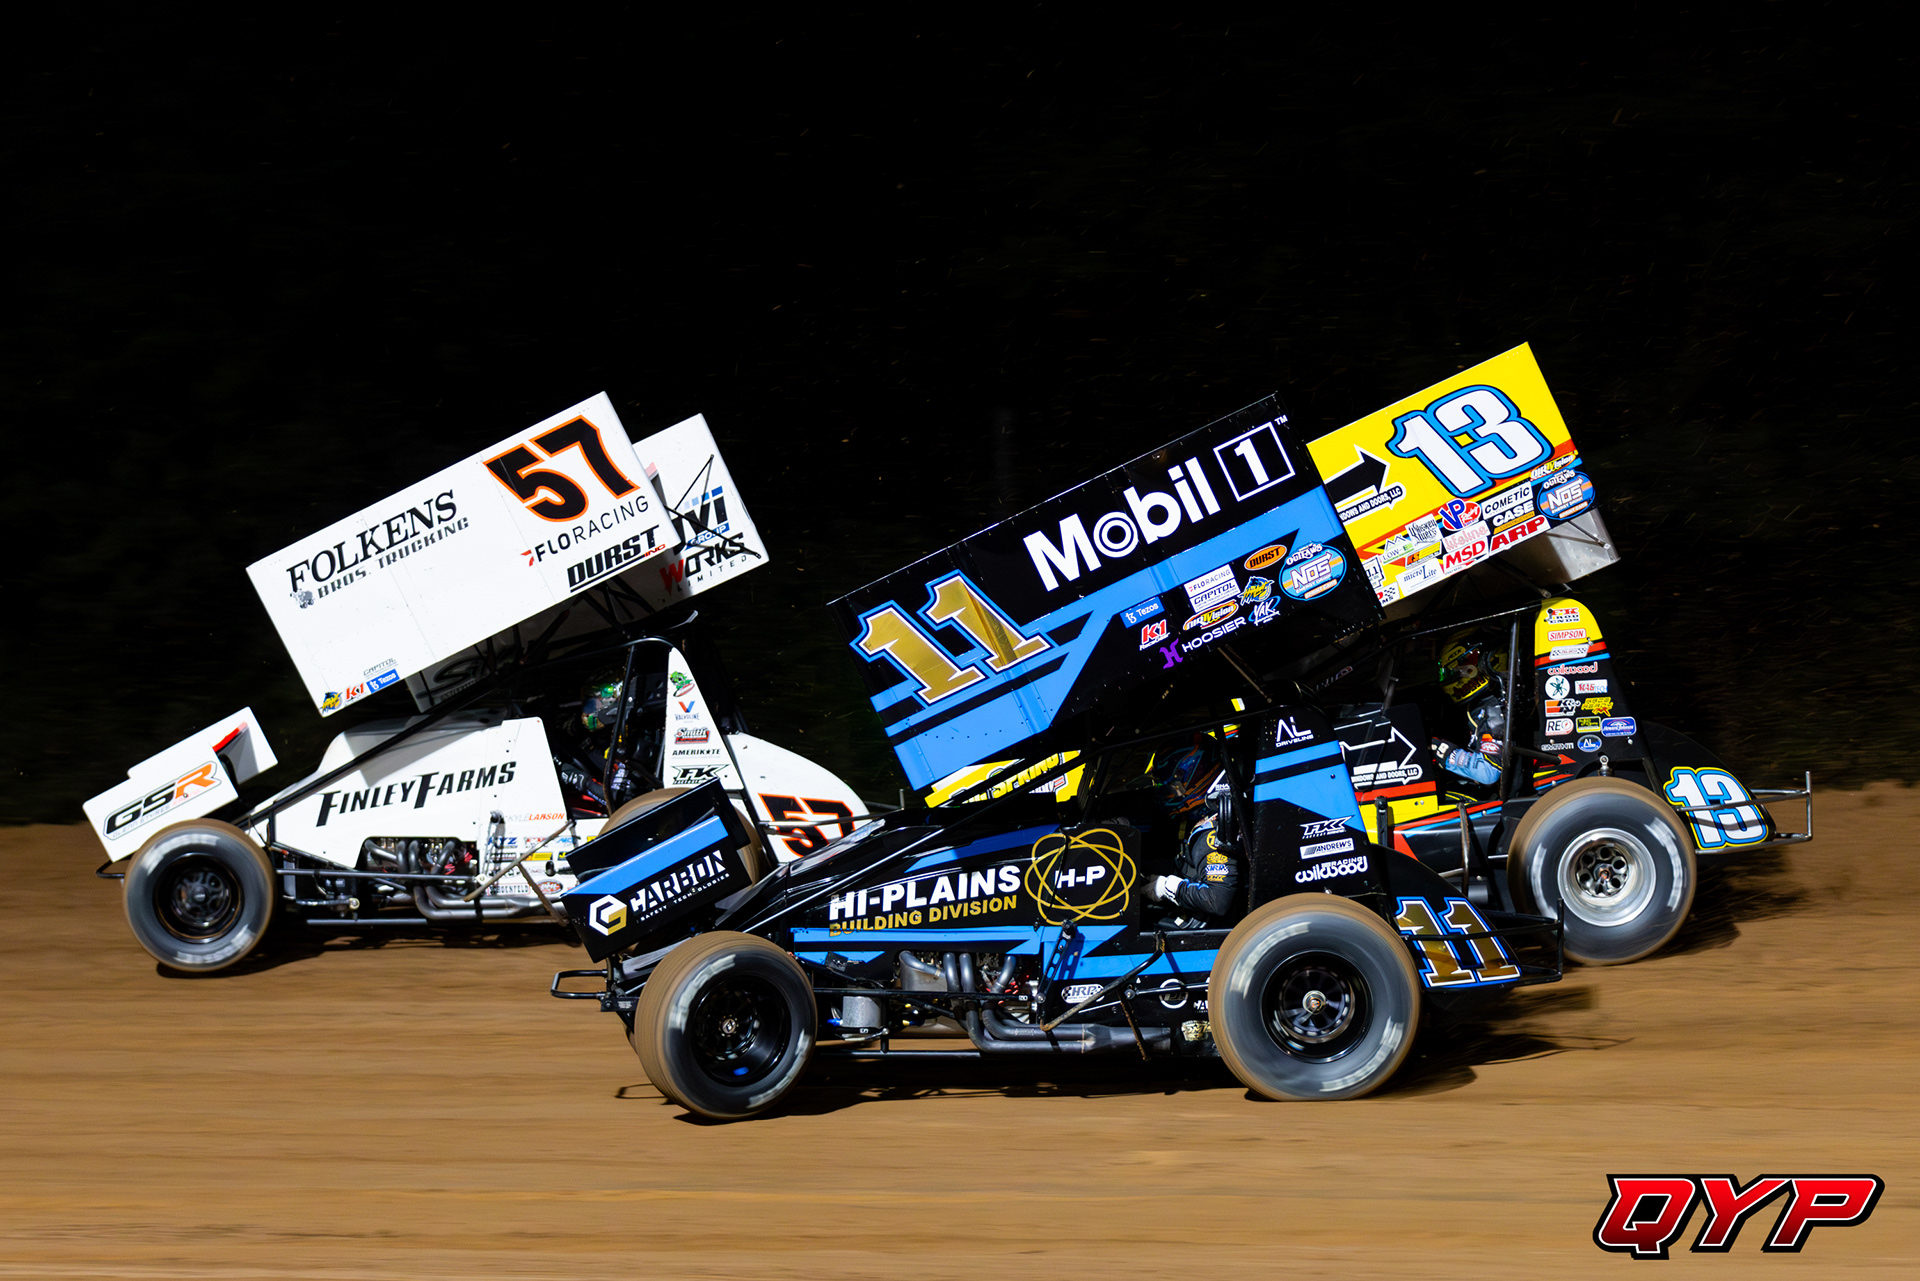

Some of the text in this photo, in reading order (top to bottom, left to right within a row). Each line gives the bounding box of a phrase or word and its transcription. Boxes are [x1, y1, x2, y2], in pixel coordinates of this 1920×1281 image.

[1385, 384, 1554, 498] 13
[483, 415, 641, 522] 57
[1358, 501, 1371, 513] AND
[1371, 492, 1390, 508] DOORS,
[1390, 487, 1401, 499] LLC
[1485, 487, 1529, 513] COMETIC
[1547, 477, 1583, 511] NOS
[535, 495, 649, 562] FLORACING
[1023, 438, 1269, 592] Mobil 1
[1440, 499, 1465, 530] VP
[1493, 501, 1534, 527] CASE
[286, 489, 457, 592] FOLKENS
[1491, 516, 1546, 552] ARP
[317, 517, 469, 599] BROS. TRUCKING
[567, 525, 659, 588] DURST
[1249, 547, 1281, 569] DURST
[1290, 551, 1333, 590] NOS
[1446, 540, 1486, 569] MSD
[677, 555, 747, 592] LIMITED
[1193, 569, 1231, 591] FLORACING
[1136, 602, 1159, 617] Tezos
[1194, 583, 1236, 605] CAPITOL
[850, 569, 1058, 706] 11
[1141, 619, 1167, 645] K1
[1182, 616, 1247, 652] HOOSIER
[1550, 630, 1584, 640] SIMPSON
[1547, 662, 1598, 675] wilwood
[1276, 734, 1314, 748] DRIVELINE
[1375, 772, 1387, 780] AND
[1407, 768, 1418, 776] LLC
[106, 763, 216, 835] GSR
[1663, 766, 1768, 850] 13
[758, 793, 857, 858] 57
[1315, 840, 1352, 852] ANDREW'S
[1054, 866, 1106, 889] H-P
[1295, 855, 1368, 883] wilwood
[829, 865, 1021, 921] HI-PLAINS
[640, 905, 668, 922] SAFETY
[829, 895, 1018, 937] BUILDING DIVISION
[1394, 896, 1522, 988] 11
